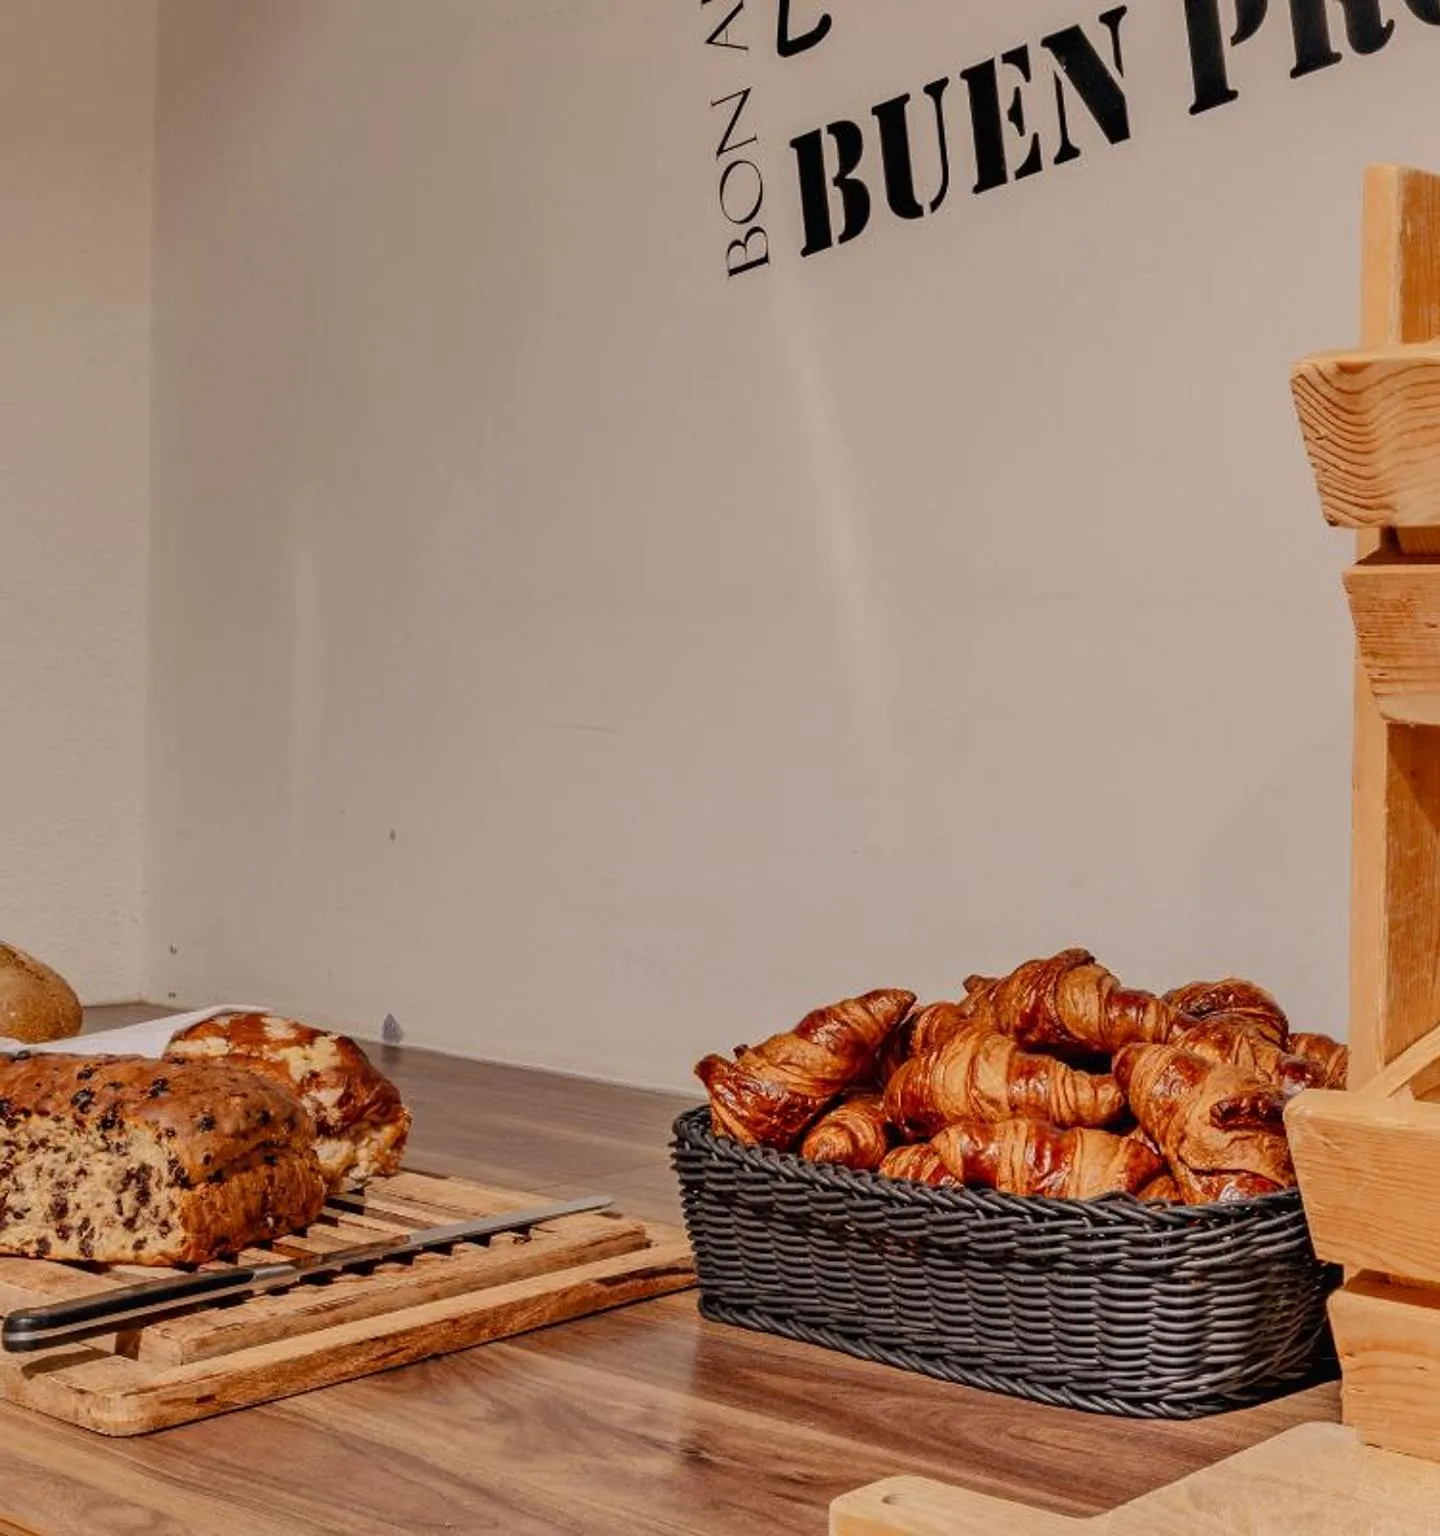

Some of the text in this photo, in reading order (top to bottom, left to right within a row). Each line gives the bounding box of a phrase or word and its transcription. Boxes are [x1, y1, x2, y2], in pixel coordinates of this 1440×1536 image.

[700, 0, 770, 278] BON A
[789, 6, 1130, 258] BUEN
